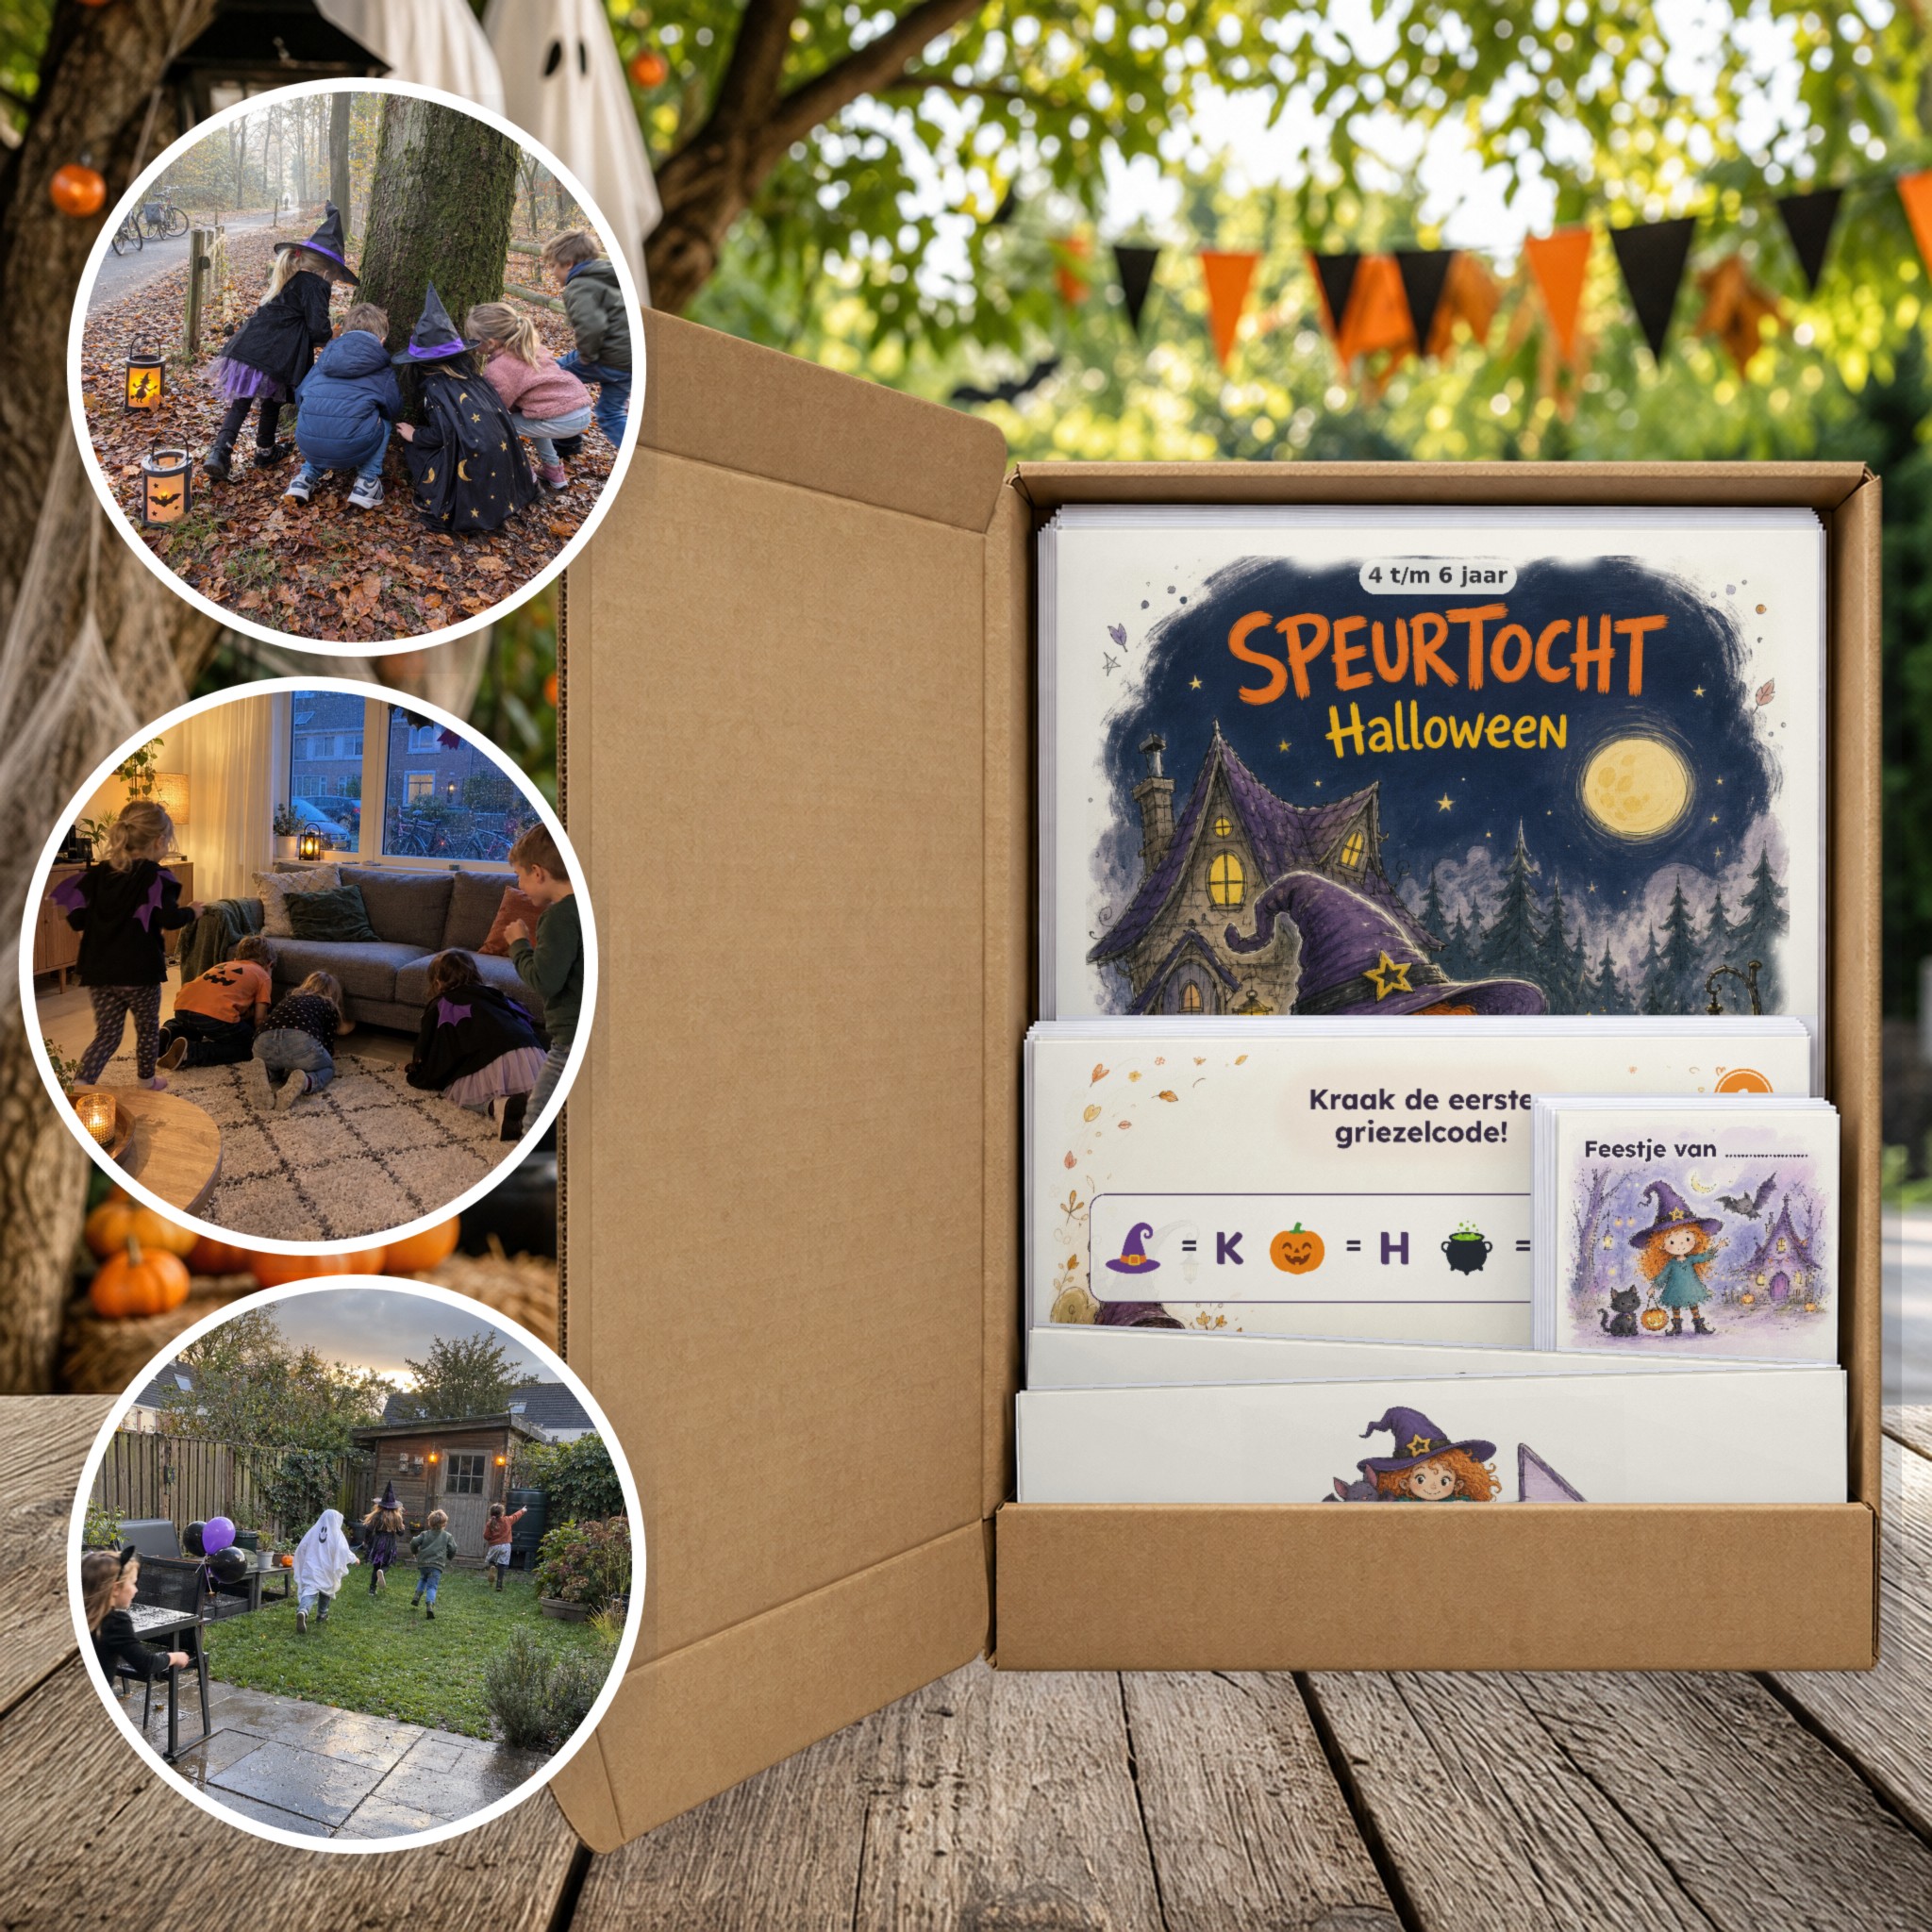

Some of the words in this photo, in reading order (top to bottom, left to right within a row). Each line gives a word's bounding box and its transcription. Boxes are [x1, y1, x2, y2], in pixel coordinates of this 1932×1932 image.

[1368, 566, 1382, 584] 4
[1390, 566, 1430, 586] t/m
[1439, 566, 1453, 584] 6
[1459, 565, 1508, 588] jaar
[1227, 603, 1670, 706] SPEURTOCHT
[1325, 699, 1567, 758] Halloween
[1309, 1088, 1396, 1110] Kraak
[1405, 1088, 1440, 1110] de
[1448, 1090, 1531, 1110] eerste
[1335, 1119, 1507, 1149] griezelcode!
[1585, 1138, 1667, 1162] Feestje
[1674, 1143, 1717, 1158] van
[1216, 1231, 1244, 1265] K
[1380, 1231, 1409, 1265] H
